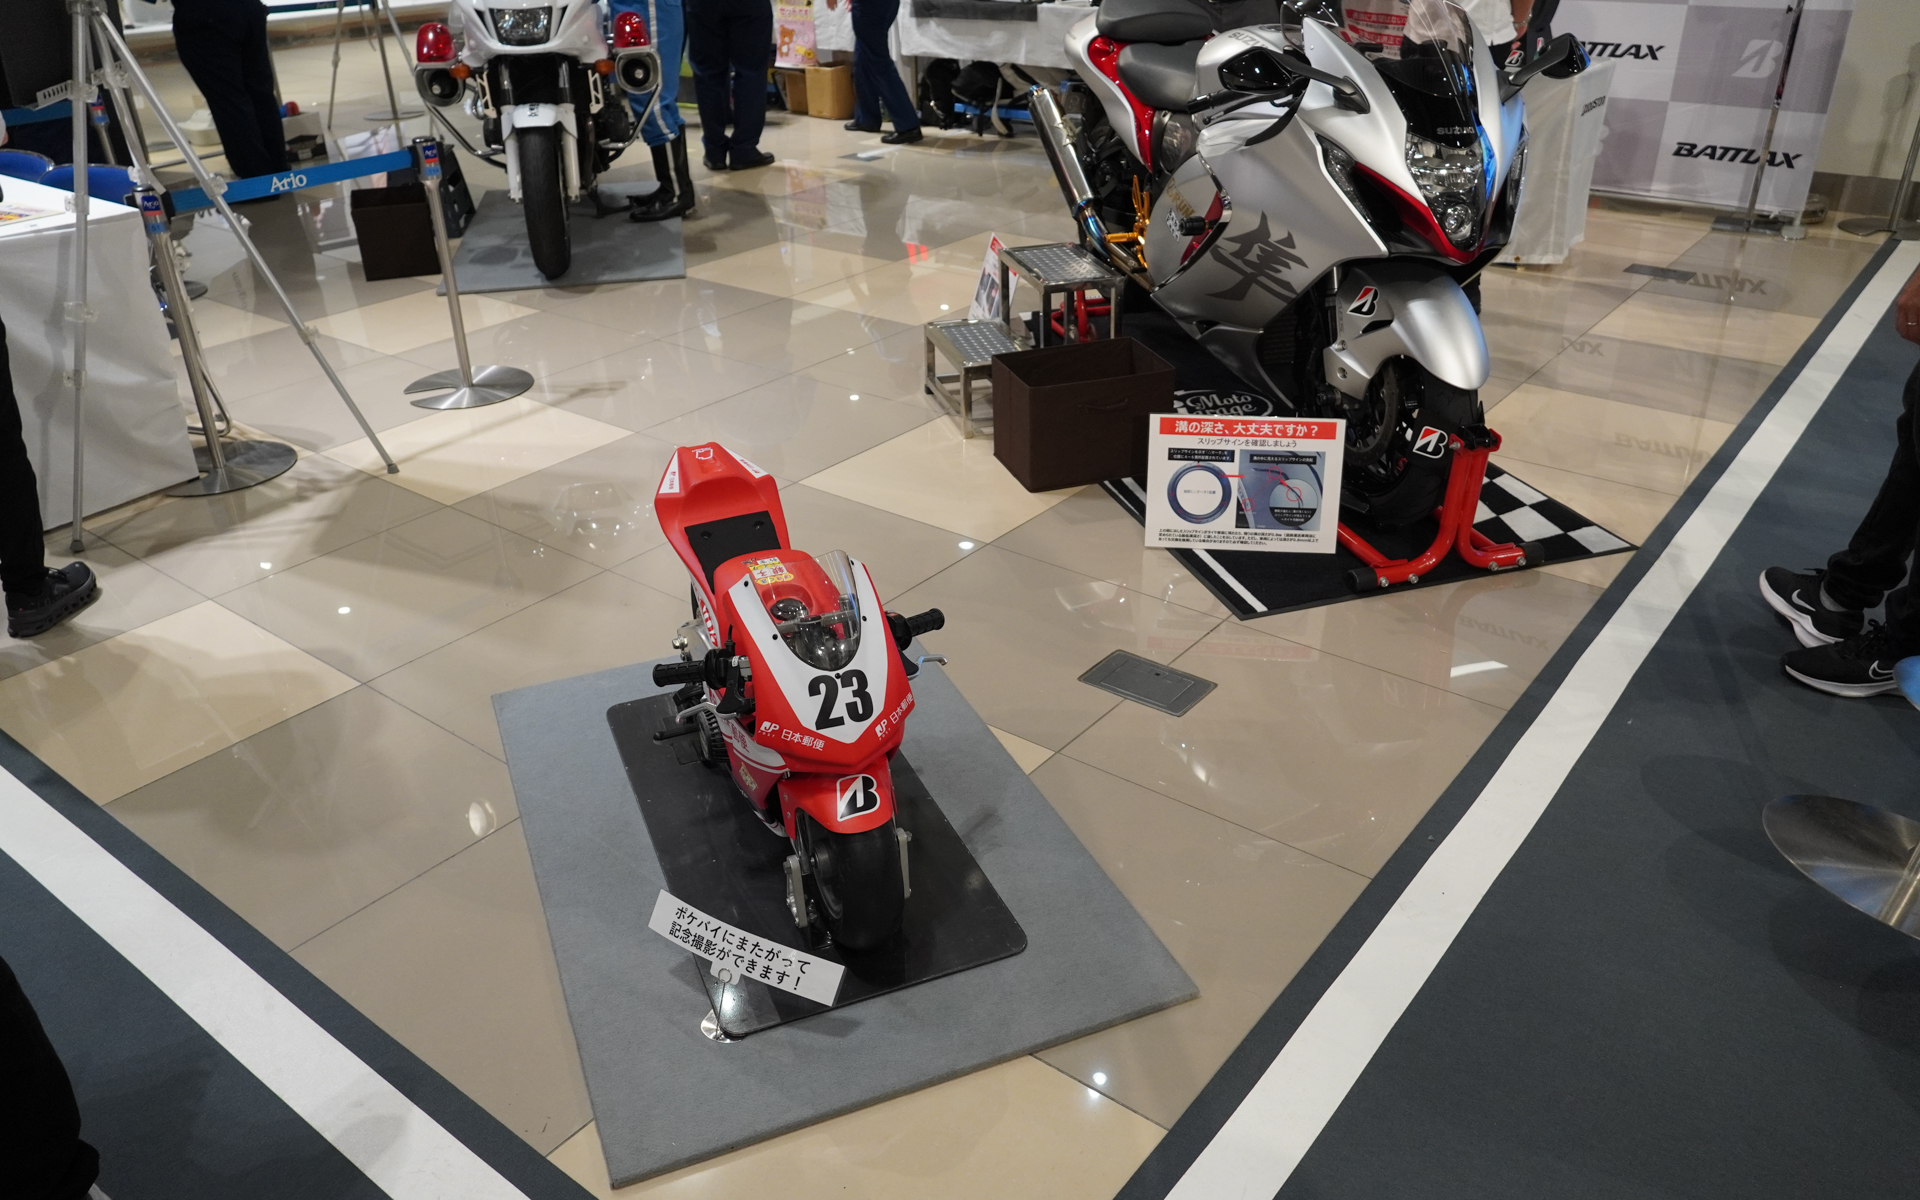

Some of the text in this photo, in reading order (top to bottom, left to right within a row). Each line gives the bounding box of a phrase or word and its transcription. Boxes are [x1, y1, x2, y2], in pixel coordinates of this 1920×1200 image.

[1436, 126, 1476, 135] SUZUKI
[269, 172, 308, 193] Ario
[1205, 210, 1309, 304] 隼
[1197, 437, 1297, 448] スリップサインを確認しましょう
[807, 669, 874, 731] 23
[889, 693, 915, 725] 日本郵便
[781, 729, 825, 752] 日本郵便
[668, 920, 802, 991] 記念撮影ができます！
[675, 906, 811, 975] ポケバイにまたがって
